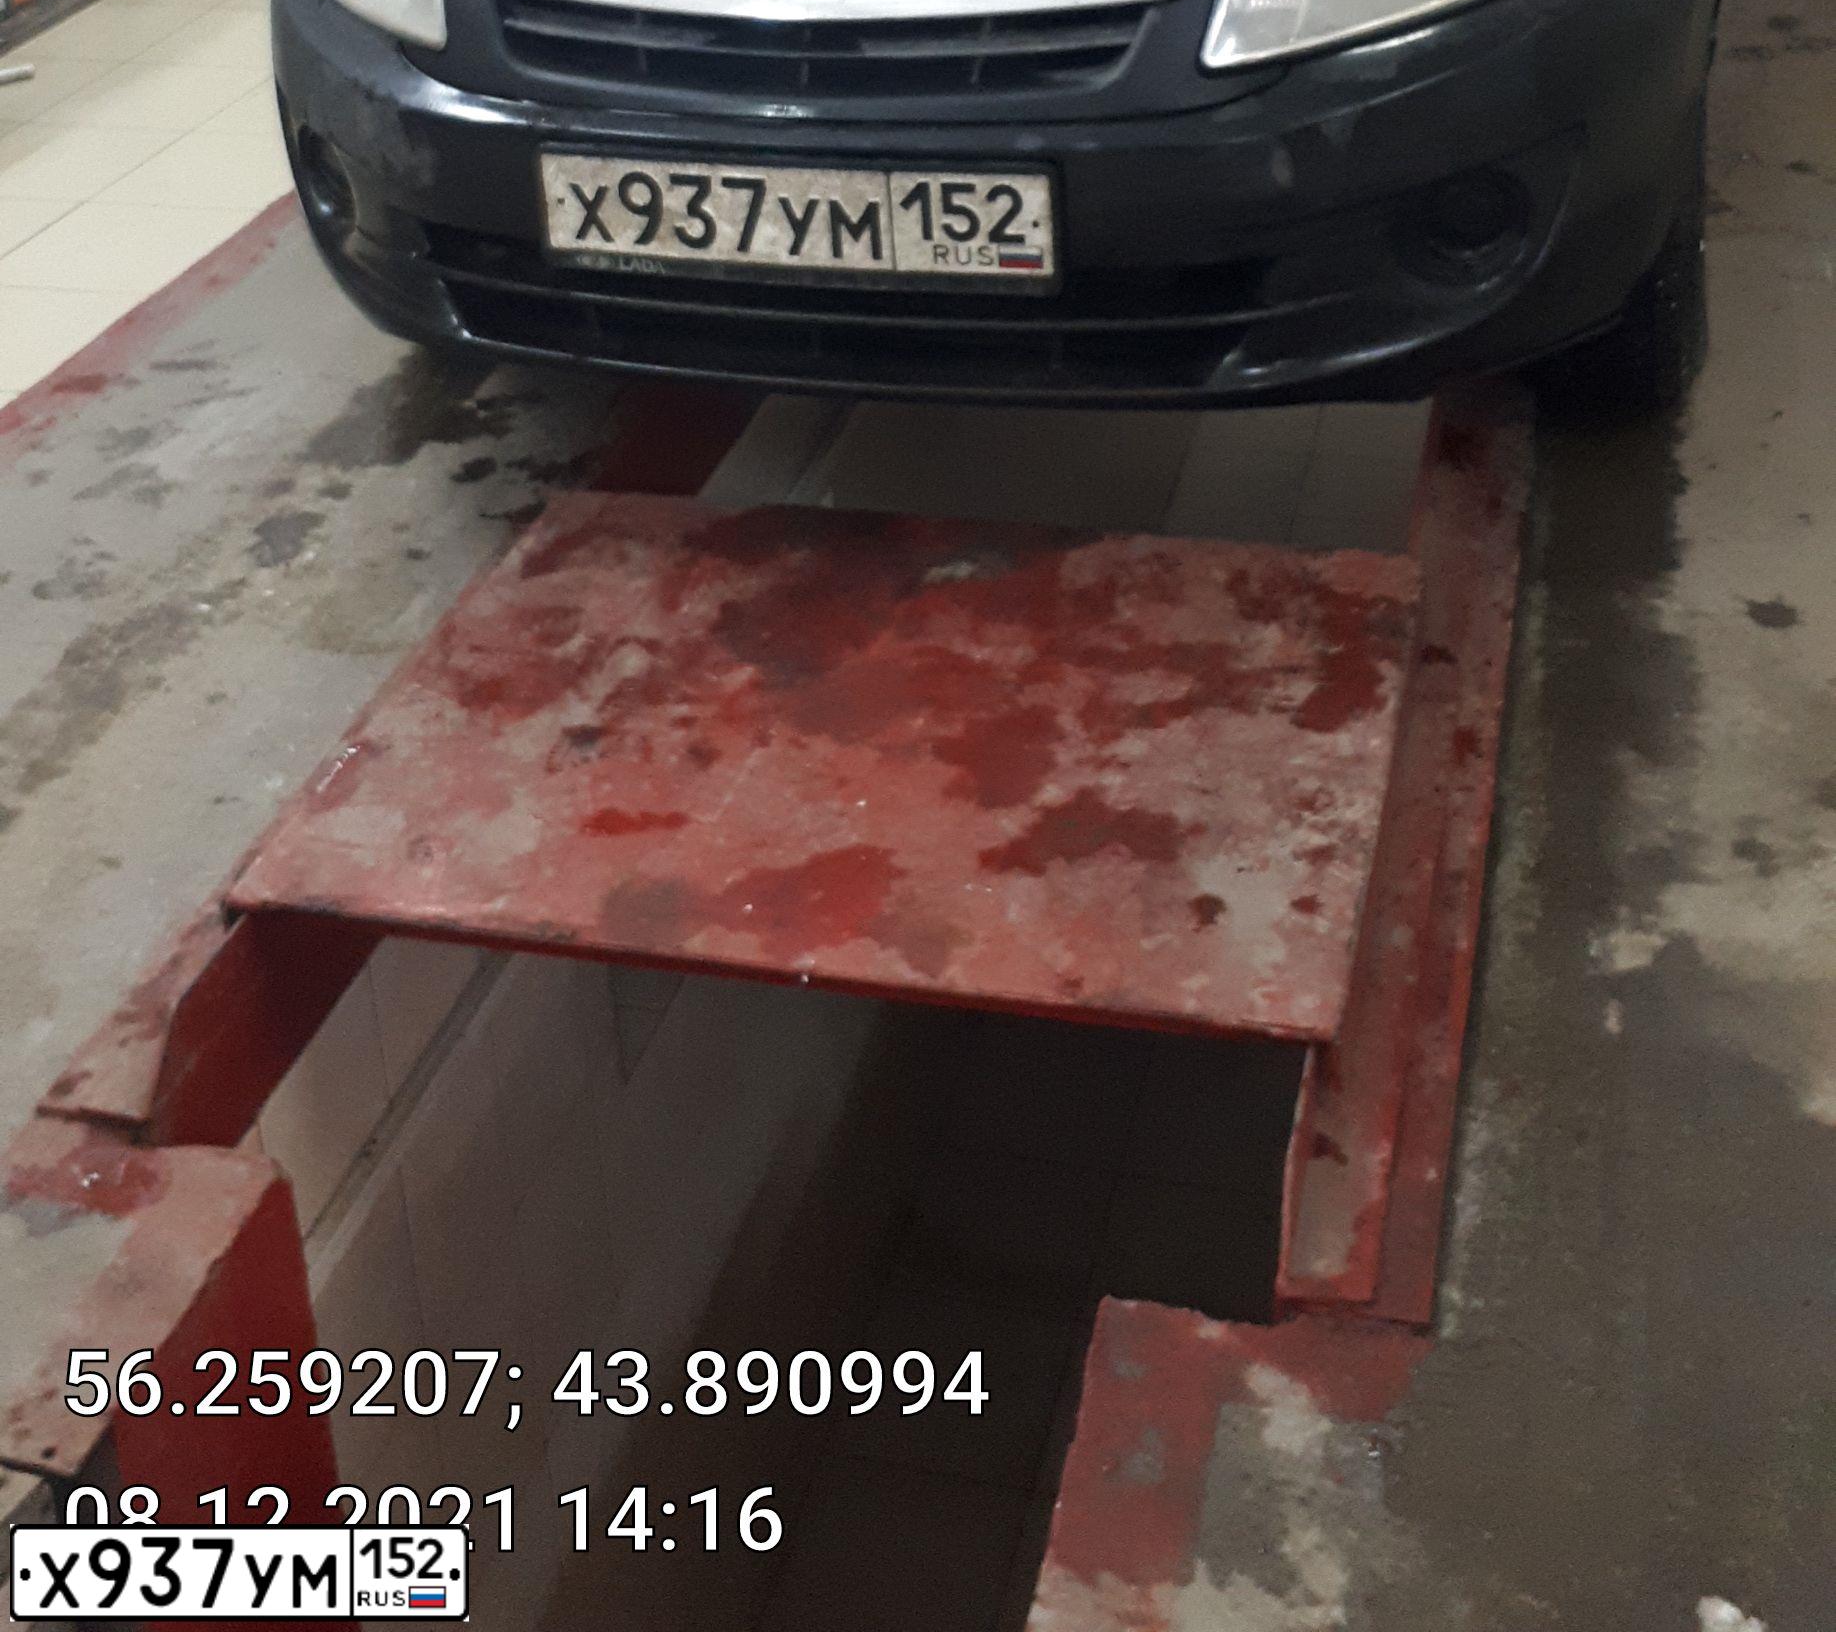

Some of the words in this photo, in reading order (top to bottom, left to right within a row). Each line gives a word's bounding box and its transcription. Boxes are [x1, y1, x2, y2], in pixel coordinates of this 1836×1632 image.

[570, 172, 883, 261] Х937УМ
[900, 182, 1026, 245] 152
[932, 245, 993, 267] RUS
